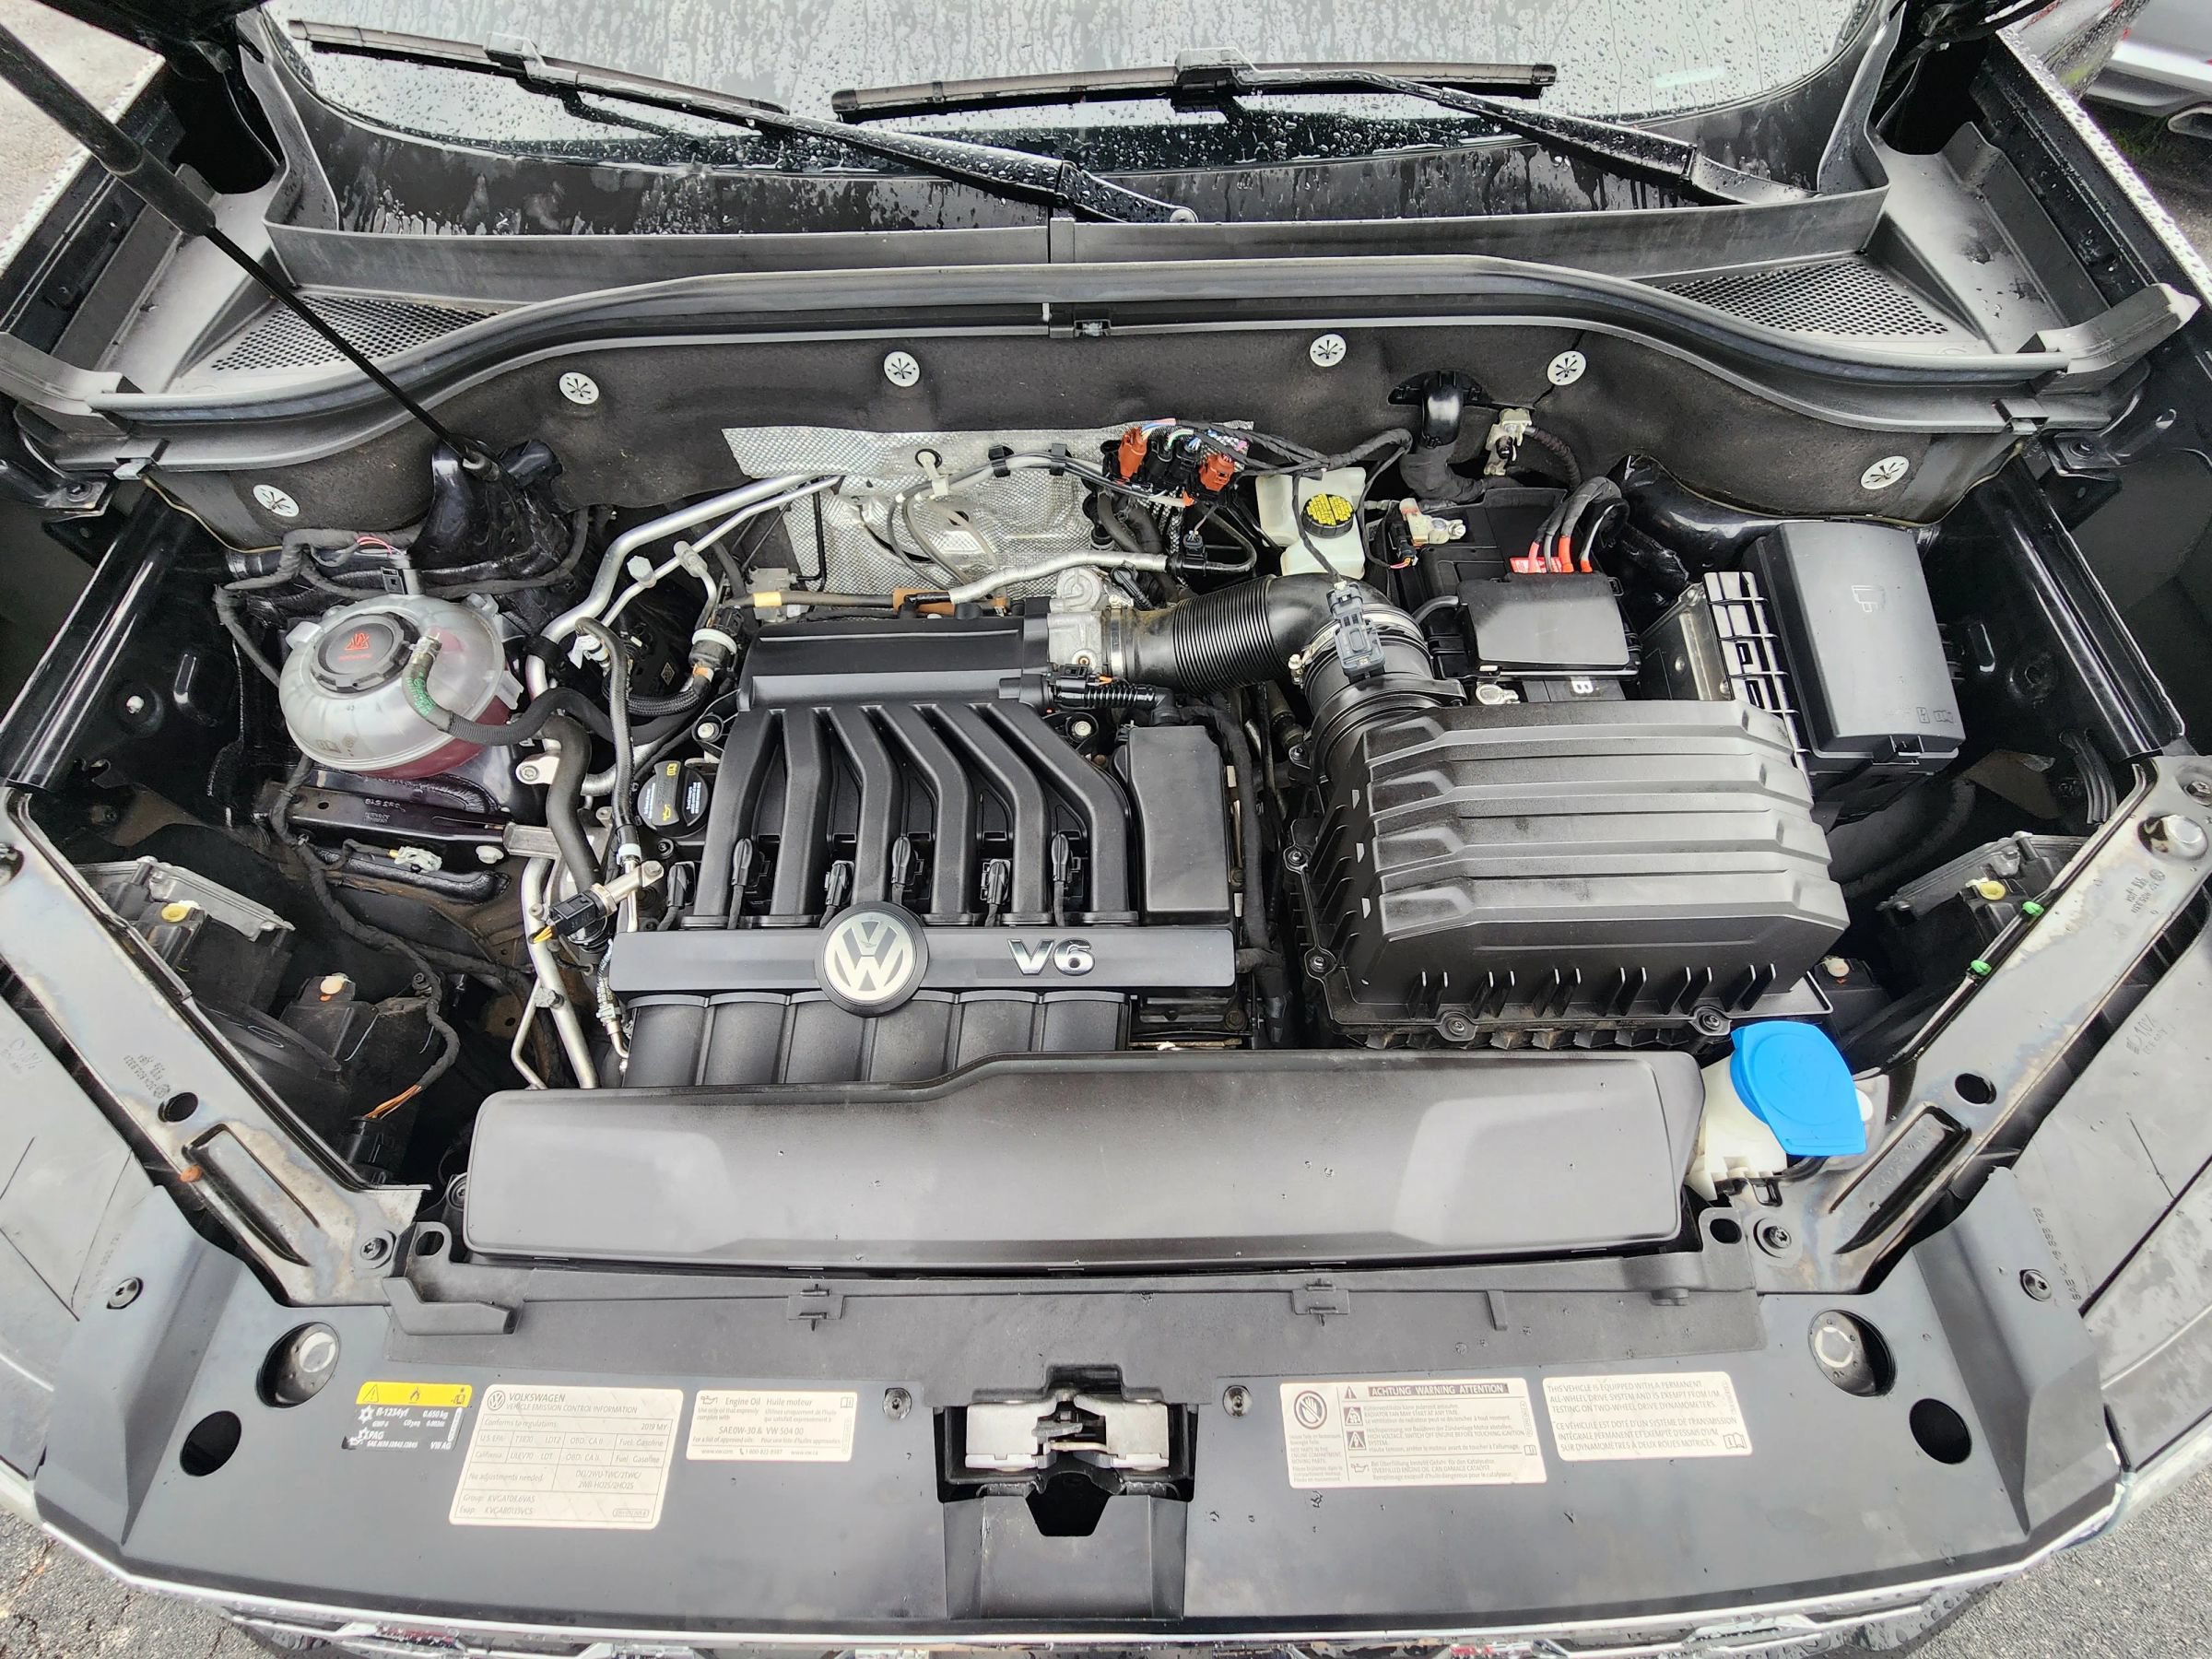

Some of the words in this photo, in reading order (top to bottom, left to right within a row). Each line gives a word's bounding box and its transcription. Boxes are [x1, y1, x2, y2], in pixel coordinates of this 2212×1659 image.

[1006, 937, 1095, 976] V6
[1662, 1380, 1702, 1388] PERMANENT
[1371, 1386, 1412, 1396] ACHTUNG
[1415, 1385, 1456, 1395] WARNING
[1459, 1384, 1504, 1394] ATTENTION
[509, 1393, 566, 1402] VOLKSWAGEN
[725, 1397, 749, 1407] Engine
[750, 1397, 761, 1406] Oil
[766, 1398, 785, 1406] Huile
[1550, 1394, 1587, 1403] ALL-WHEEL
[532, 1403, 561, 1411] EMISSION
[563, 1404, 591, 1412] CONTROL
[593, 1404, 637, 1413] INFORMATION
[1594, 1403, 1637, 1411] TWO-WHEEL
[1565, 1421, 1598, 1429] VÉHICULE
[1611, 1420, 1629, 1428] DOTÉ
[757, 1426, 763, 1435] &
[766, 1426, 779, 1435] VW
[1559, 1432, 1594, 1440] INTÉGRALE
[633, 1455, 660, 1464] Gasoline
[479, 1473, 518, 1482] adjustments
